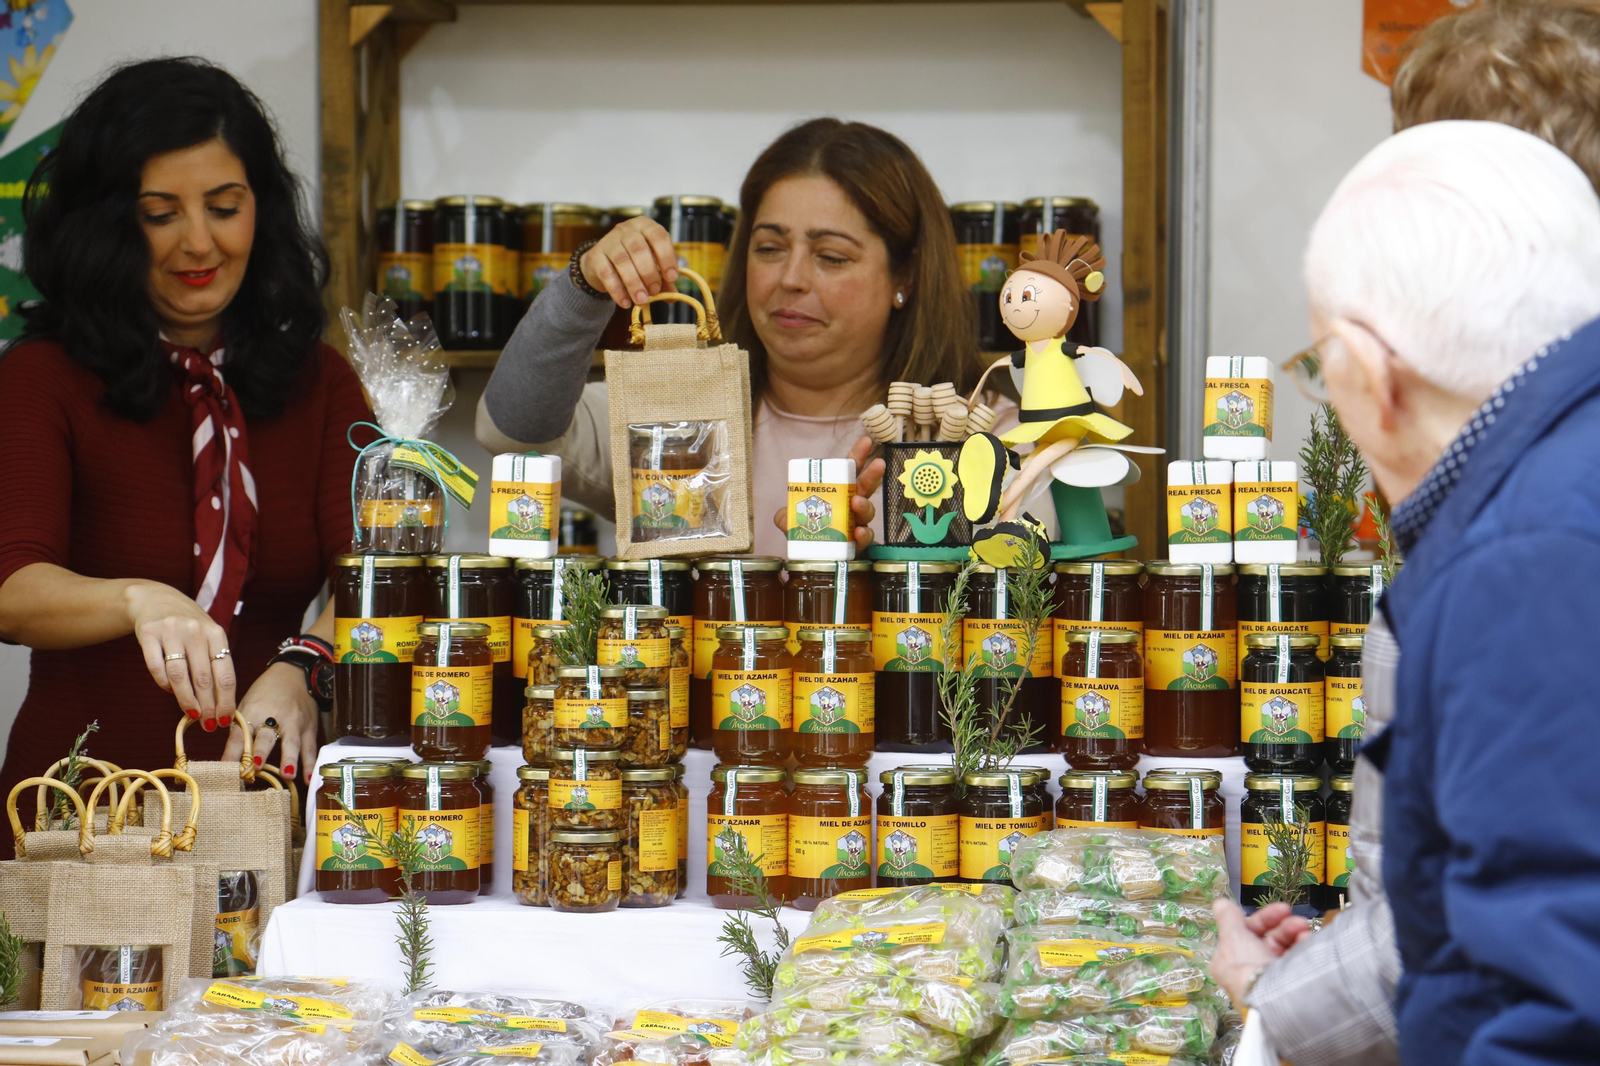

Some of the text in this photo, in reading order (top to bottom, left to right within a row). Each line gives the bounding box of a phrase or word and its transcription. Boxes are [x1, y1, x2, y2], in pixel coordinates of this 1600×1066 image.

[1215, 425, 1252, 436] MORAMIEL
[645, 473, 663, 481] CON
[1190, 488, 1222, 496] FRESCA
[505, 528, 542, 540] MORAMIEL
[794, 529, 831, 540] MORAMIEL
[1180, 532, 1219, 543] MORAMIEL
[1246, 530, 1285, 541] MORAMIEL
[880, 616, 895, 624] MIEL
[520, 622, 535, 630] MIEL
[1240, 624, 1255, 632] MIEL
[1266, 624, 1309, 632] AGUACATE
[1338, 626, 1354, 634] MIEL
[1163, 632, 1182, 640] MIEL
[1196, 632, 1226, 640] AZAHAR
[488, 640, 509, 648] OMERO
[350, 652, 385, 663] MORAMIEL
[895, 660, 931, 671] MORAMIEL
[746, 673, 778, 681] AZAHAR
[981, 666, 1017, 678] MORAMIEL
[826, 676, 858, 684] AZAHAR
[1181, 678, 1218, 689] MORAMIEL
[1243, 687, 1257, 695] MIEL
[1330, 682, 1346, 690] MIEL
[424, 714, 460, 726] MORAMIEL
[729, 718, 766, 729] MORAMIEL
[808, 721, 845, 733] MORAMIEL
[1073, 725, 1110, 738] MORAMIEL
[1259, 731, 1298, 743] MORAMIEL
[883, 820, 890, 828] DE
[1246, 828, 1262, 836] MIEL
[1328, 829, 1341, 838] MIEL
[331, 858, 369, 870] MORAMIEL
[414, 860, 452, 870] MORAMIEL
[884, 866, 917, 877] MORAMIEL
[93, 985, 158, 994] MIEL DE AZAHAR
[210, 990, 256, 1005] CARAMELOS
[640, 1023, 681, 1031] CARAMELOS
